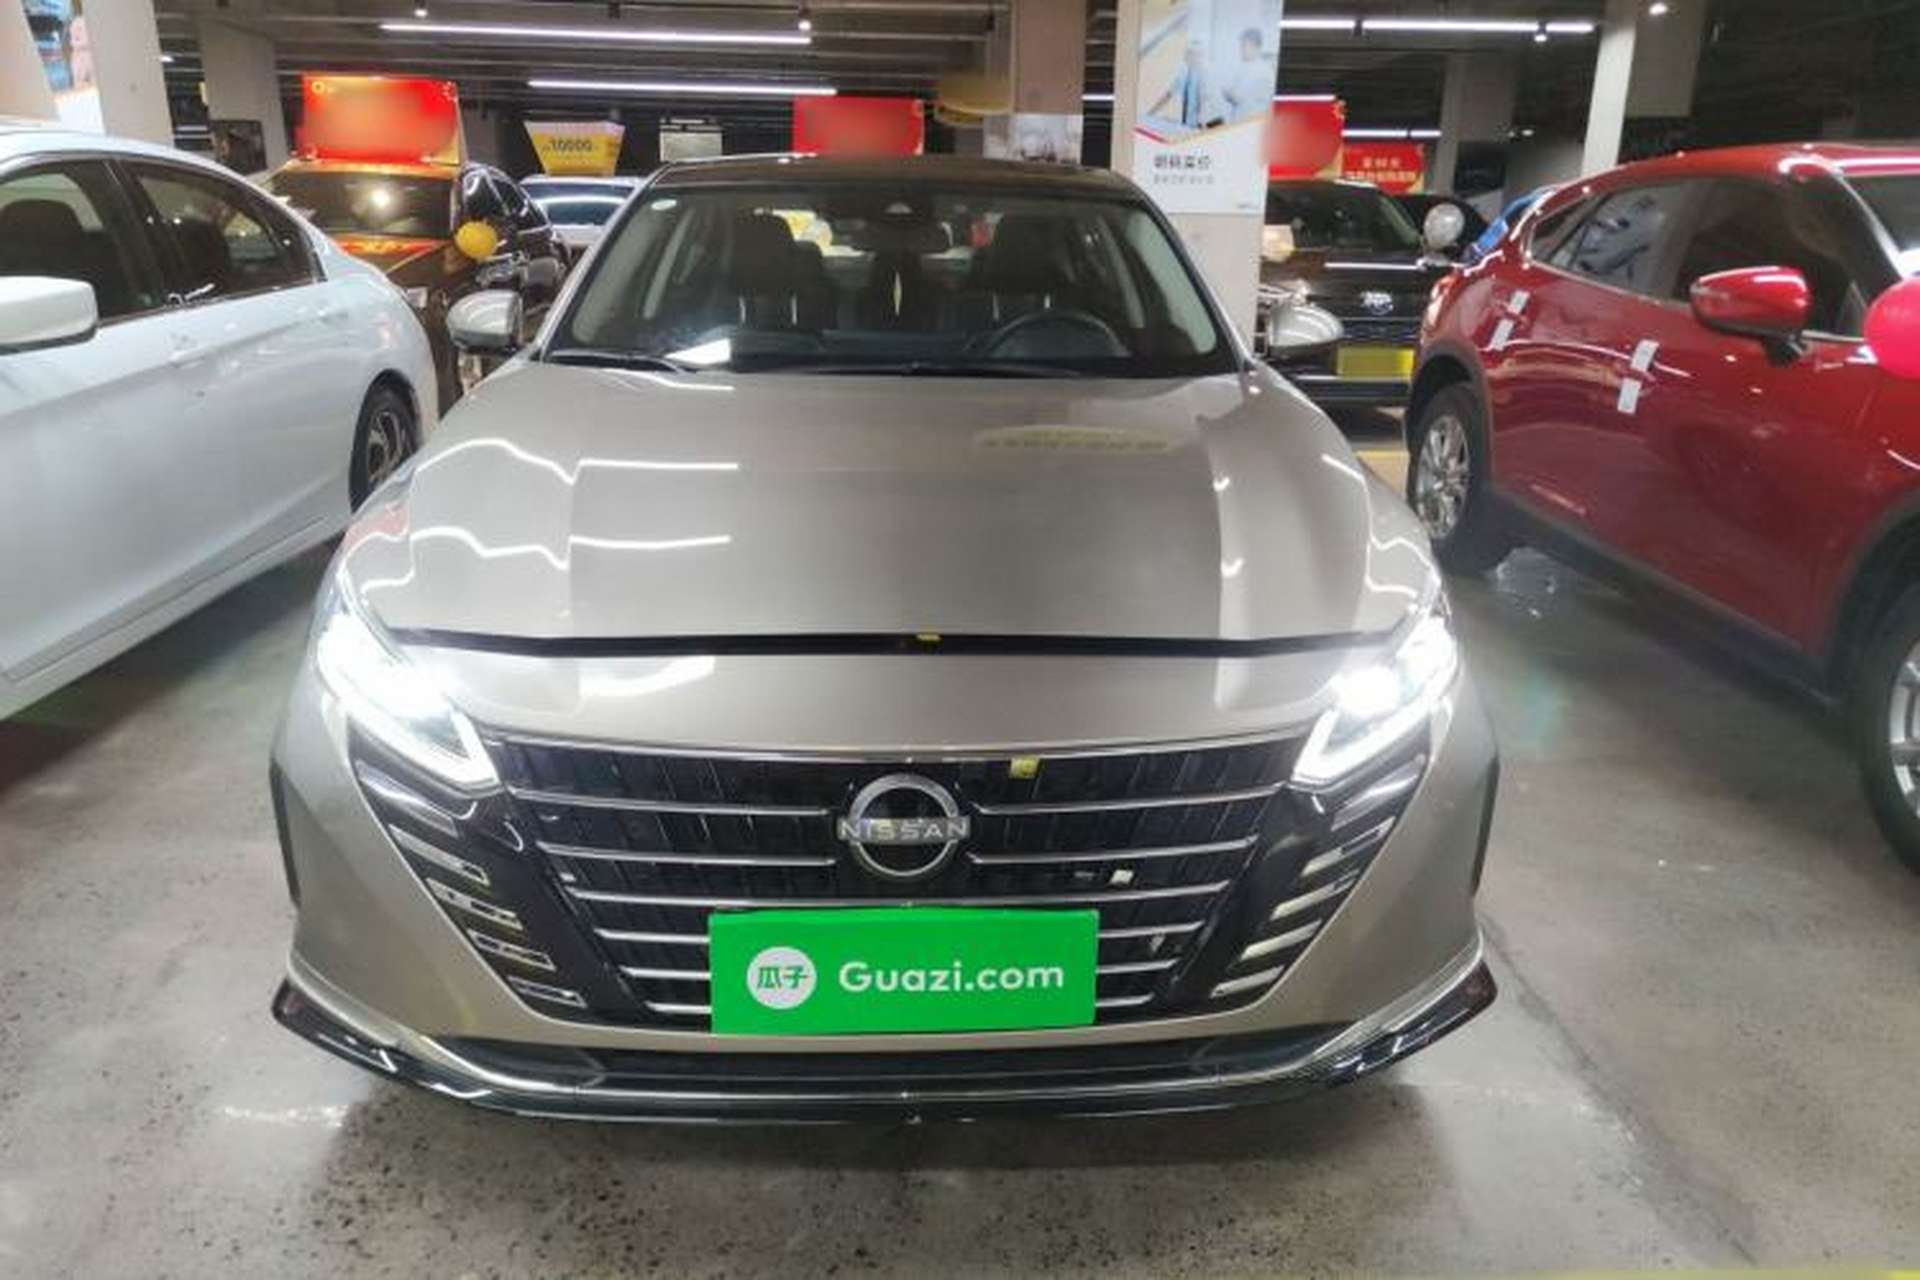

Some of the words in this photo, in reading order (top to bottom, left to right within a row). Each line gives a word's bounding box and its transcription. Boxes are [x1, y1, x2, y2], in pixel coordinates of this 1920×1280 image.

[839, 818, 968, 840] NISSAN
[757, 965, 808, 989] 瓜子
[839, 960, 1064, 992] Guazi.com
